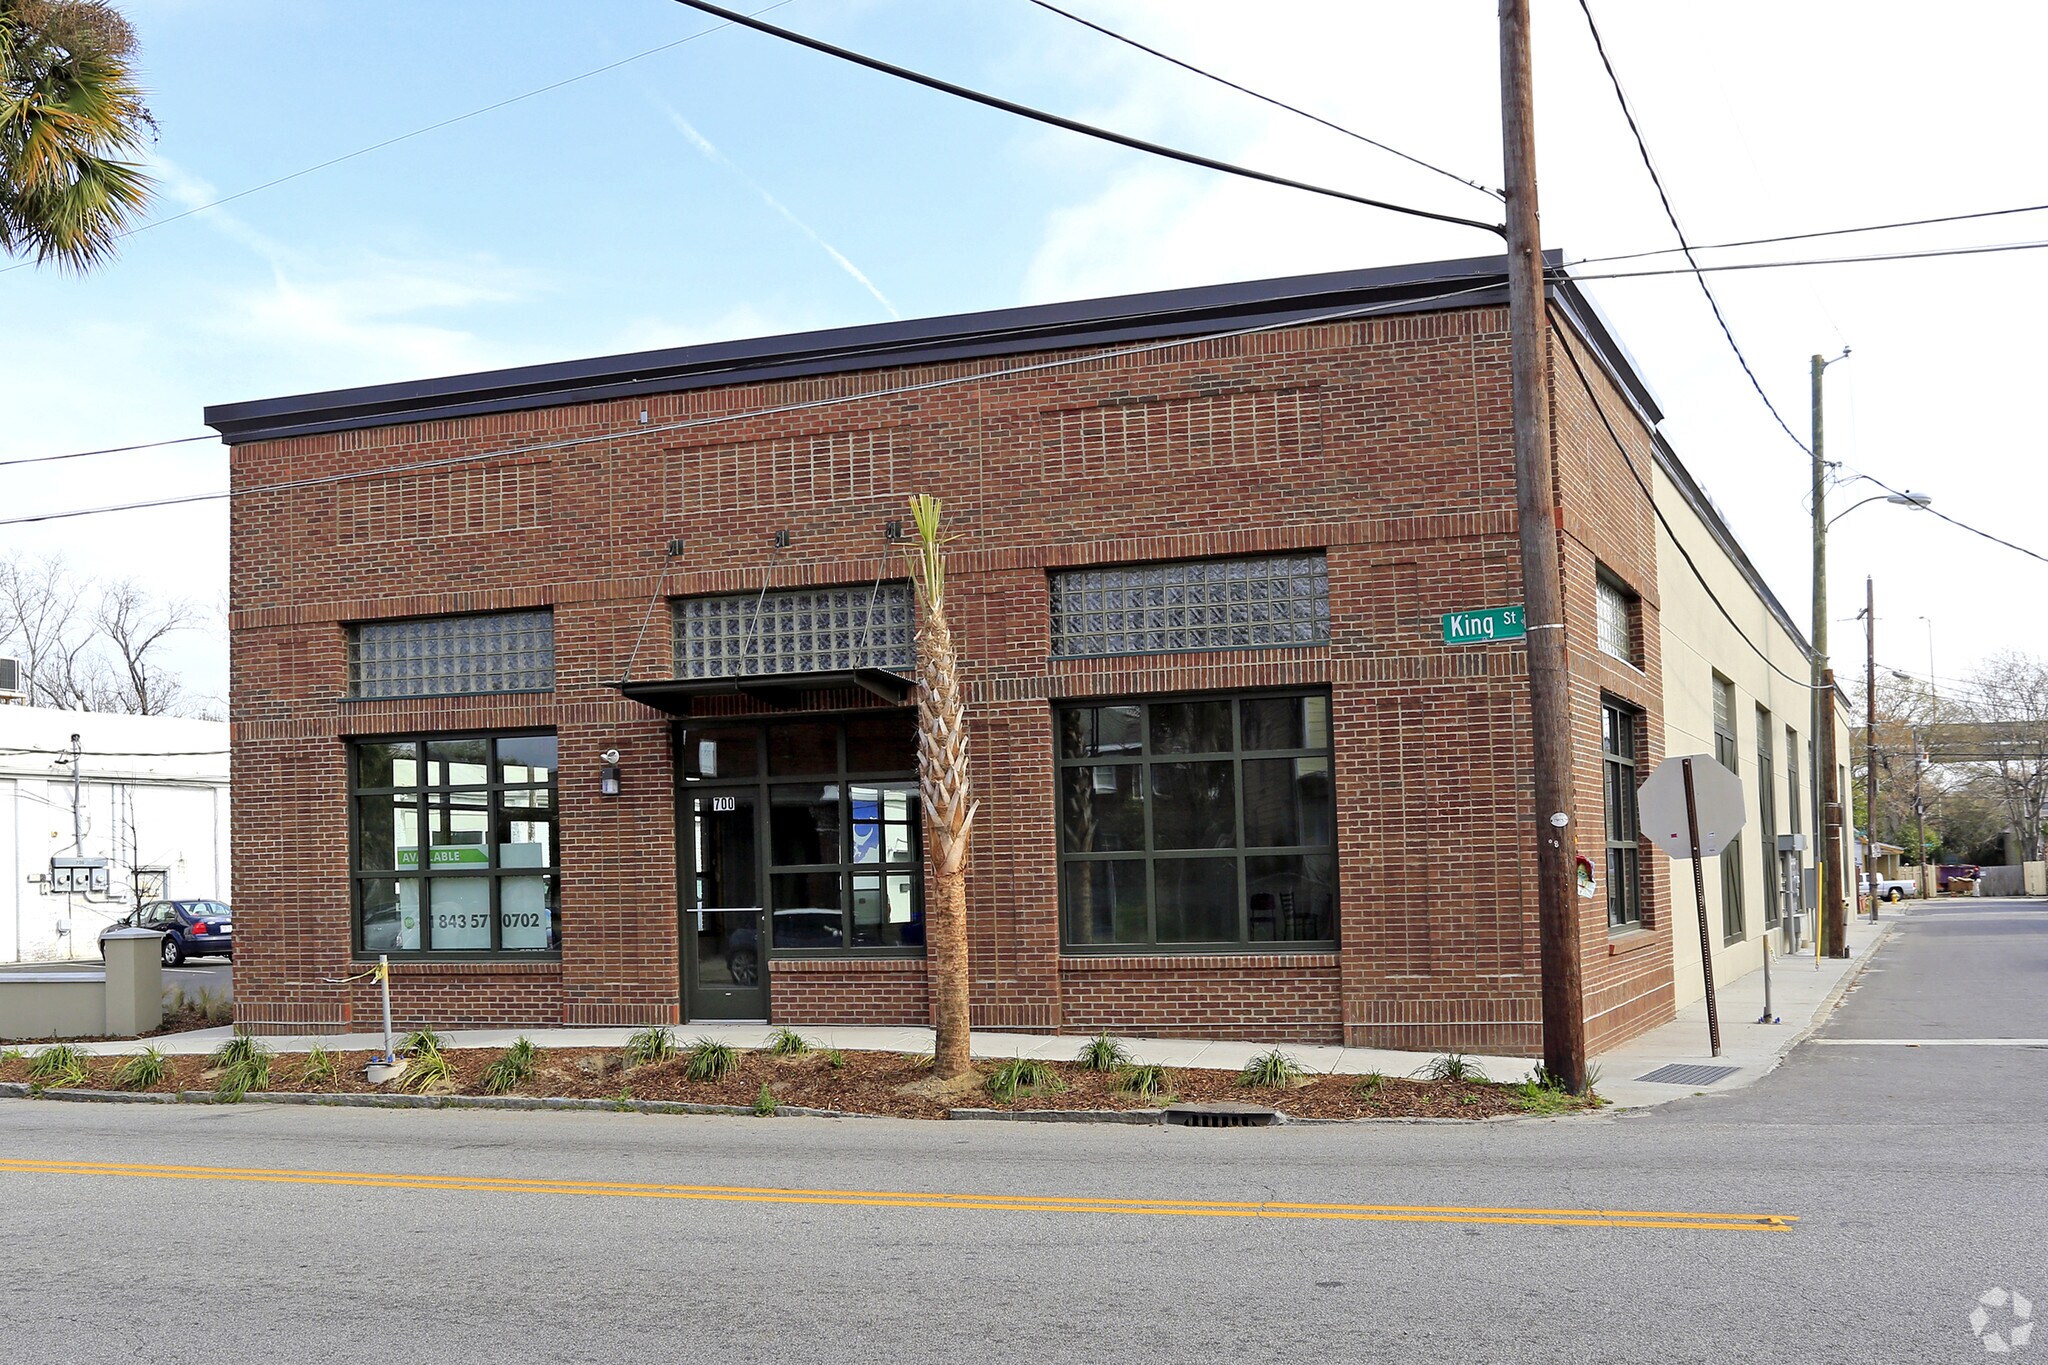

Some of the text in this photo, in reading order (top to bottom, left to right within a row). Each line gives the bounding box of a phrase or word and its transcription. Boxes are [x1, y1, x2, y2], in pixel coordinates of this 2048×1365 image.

[1451, 611, 1517, 639] King St
[714, 797, 734, 810] 700
[402, 851, 460, 862] AVABLE
[438, 914, 467, 929] 843
[470, 914, 491, 928] 57
[502, 913, 540, 928] 0702
